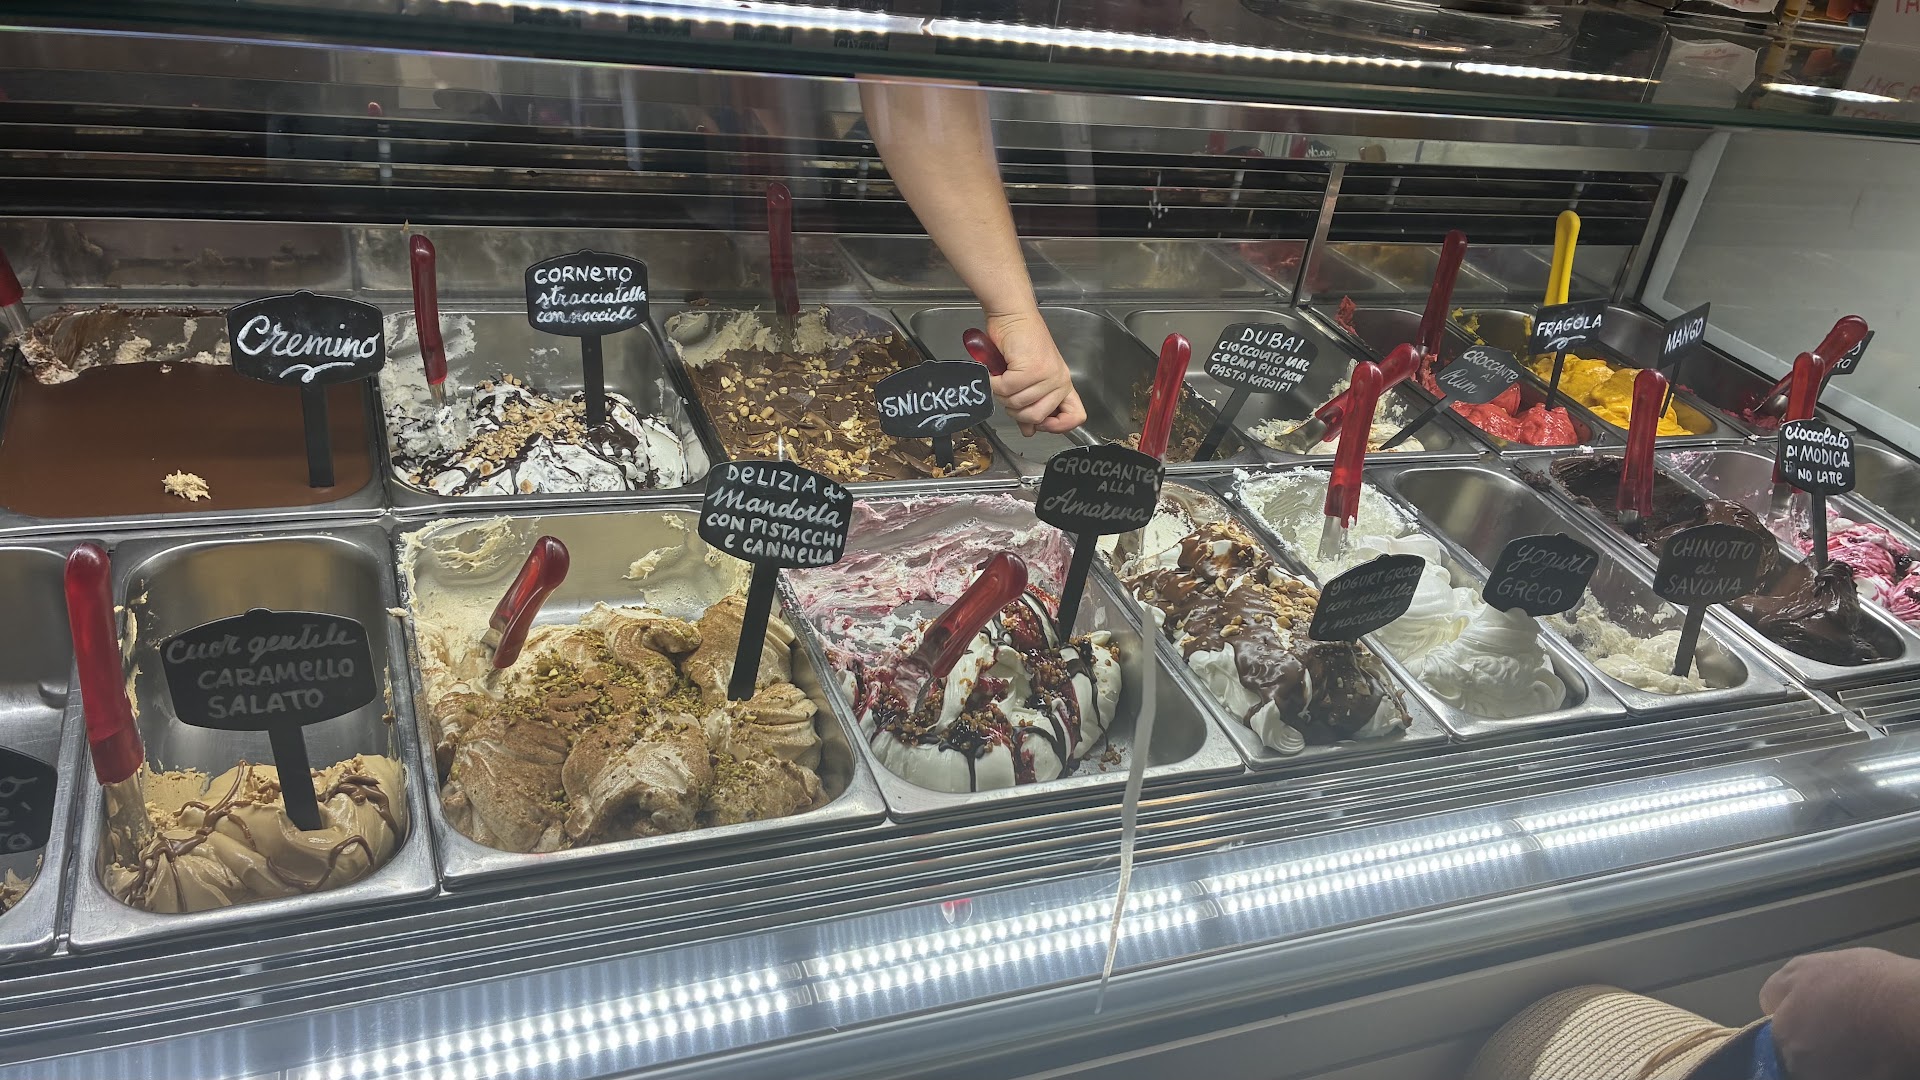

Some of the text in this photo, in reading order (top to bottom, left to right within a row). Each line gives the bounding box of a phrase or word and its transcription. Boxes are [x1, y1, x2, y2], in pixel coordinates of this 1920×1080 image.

[535, 282, 647, 309] stracciatella
[237, 315, 380, 357] Cremino
[1537, 313, 1602, 336] FRAGOLA
[1664, 317, 1703, 355] MANGO
[1219, 341, 1284, 364] CIOCCOLATO
[1240, 328, 1305, 353] DUBAI
[1210, 364, 1292, 392] PASTA KATAIFI
[1097, 480, 1135, 495] ALLA
[1798, 468, 1812, 482] NO
[706, 486, 844, 528] Mandorla
[706, 512, 843, 548] CON PISTACCHI
[1672, 538, 1755, 560] CHINOTTO
[1664, 574, 1742, 596] SAVONA
[207, 687, 325, 720] SALATO
